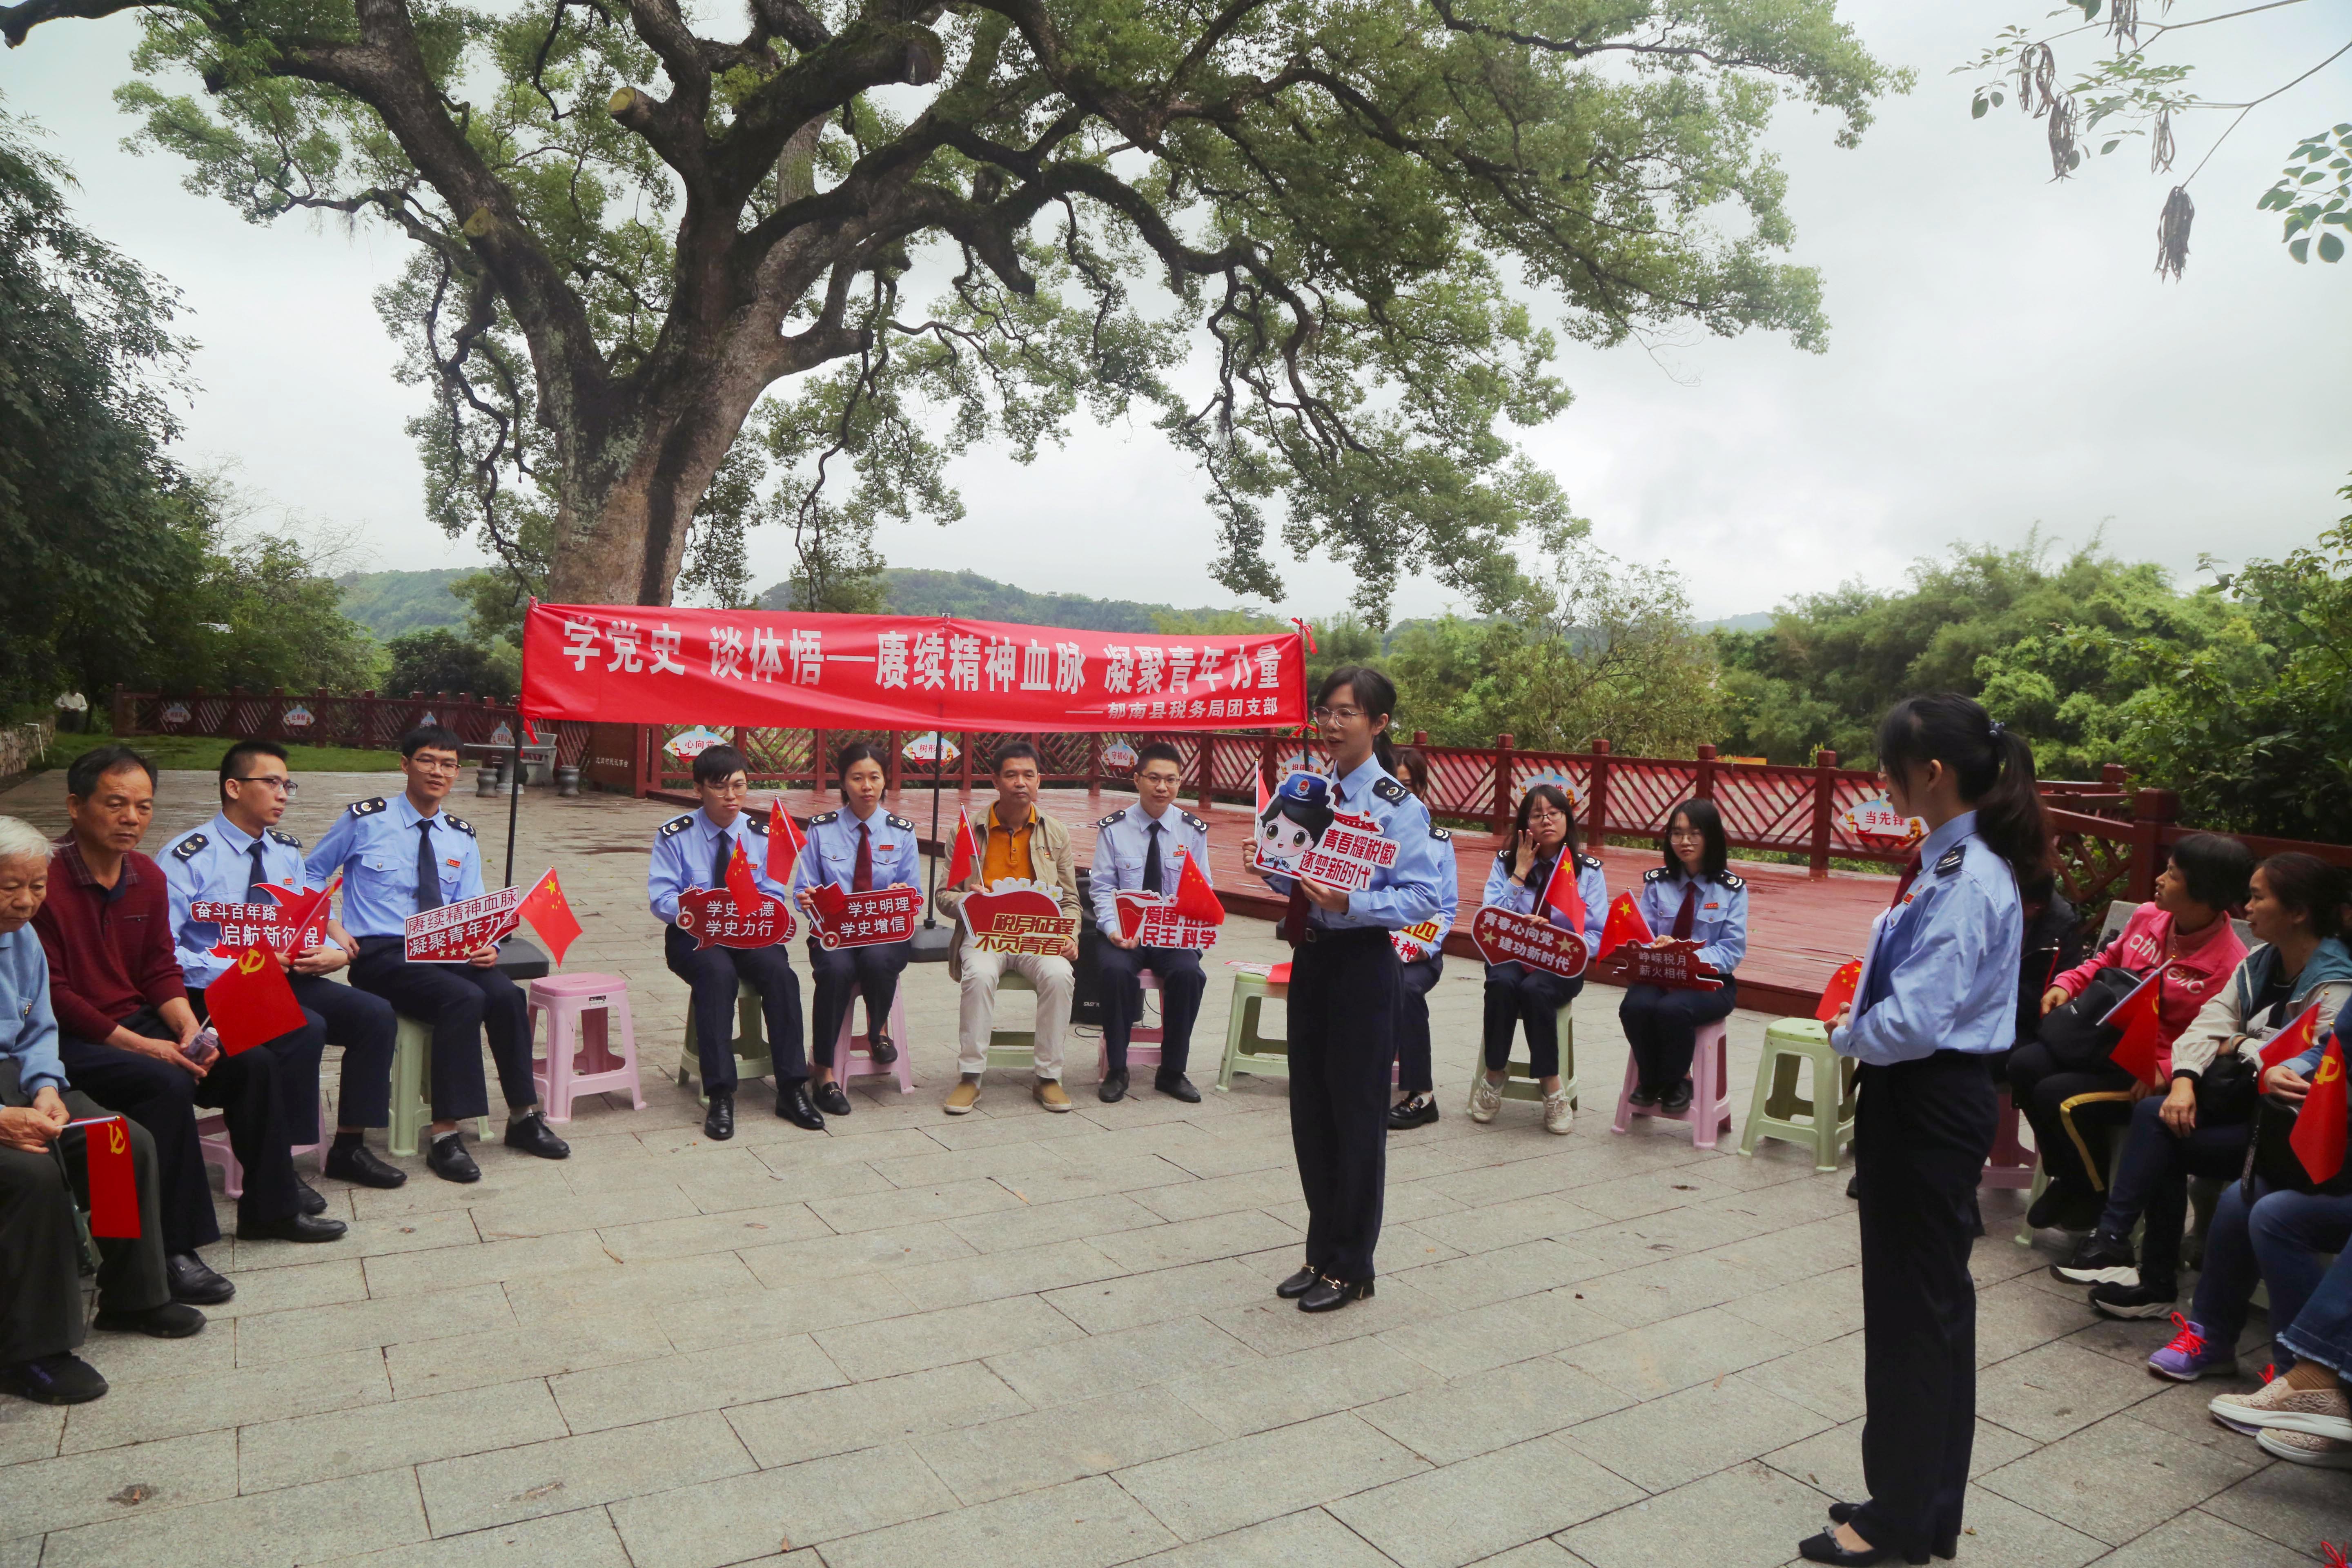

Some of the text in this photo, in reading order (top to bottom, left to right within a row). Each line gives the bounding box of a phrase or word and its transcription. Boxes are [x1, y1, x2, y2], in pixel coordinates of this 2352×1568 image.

[563, 616, 685, 676] 学党史
[1103, 643, 1281, 695] 凝聚青年力量
[1112, 751, 1128, 760] 守初心
[1865, 811, 1906, 826] 当先锋
[1323, 829, 1396, 866] 青春耀税徽
[1298, 850, 1371, 889] 逐梦新时代
[196, 903, 278, 922] 奋斗百年路
[408, 890, 519, 936] 赓续精神血脉
[706, 900, 775, 918] 学史德
[848, 897, 911, 918] 学史明理
[409, 911, 519, 957] 凝聚青年力量
[706, 920, 774, 937] 学史力行
[840, 915, 905, 938] 学史增信
[993, 913, 1076, 935] 税月征程
[1484, 911, 1555, 947] 青春心向党
[974, 932, 1066, 956] 不负青春
[1498, 935, 1570, 972] 建功新时代
[1639, 951, 1686, 967] 峥嵘税月
[1639, 964, 1687, 980] 薪火相传
